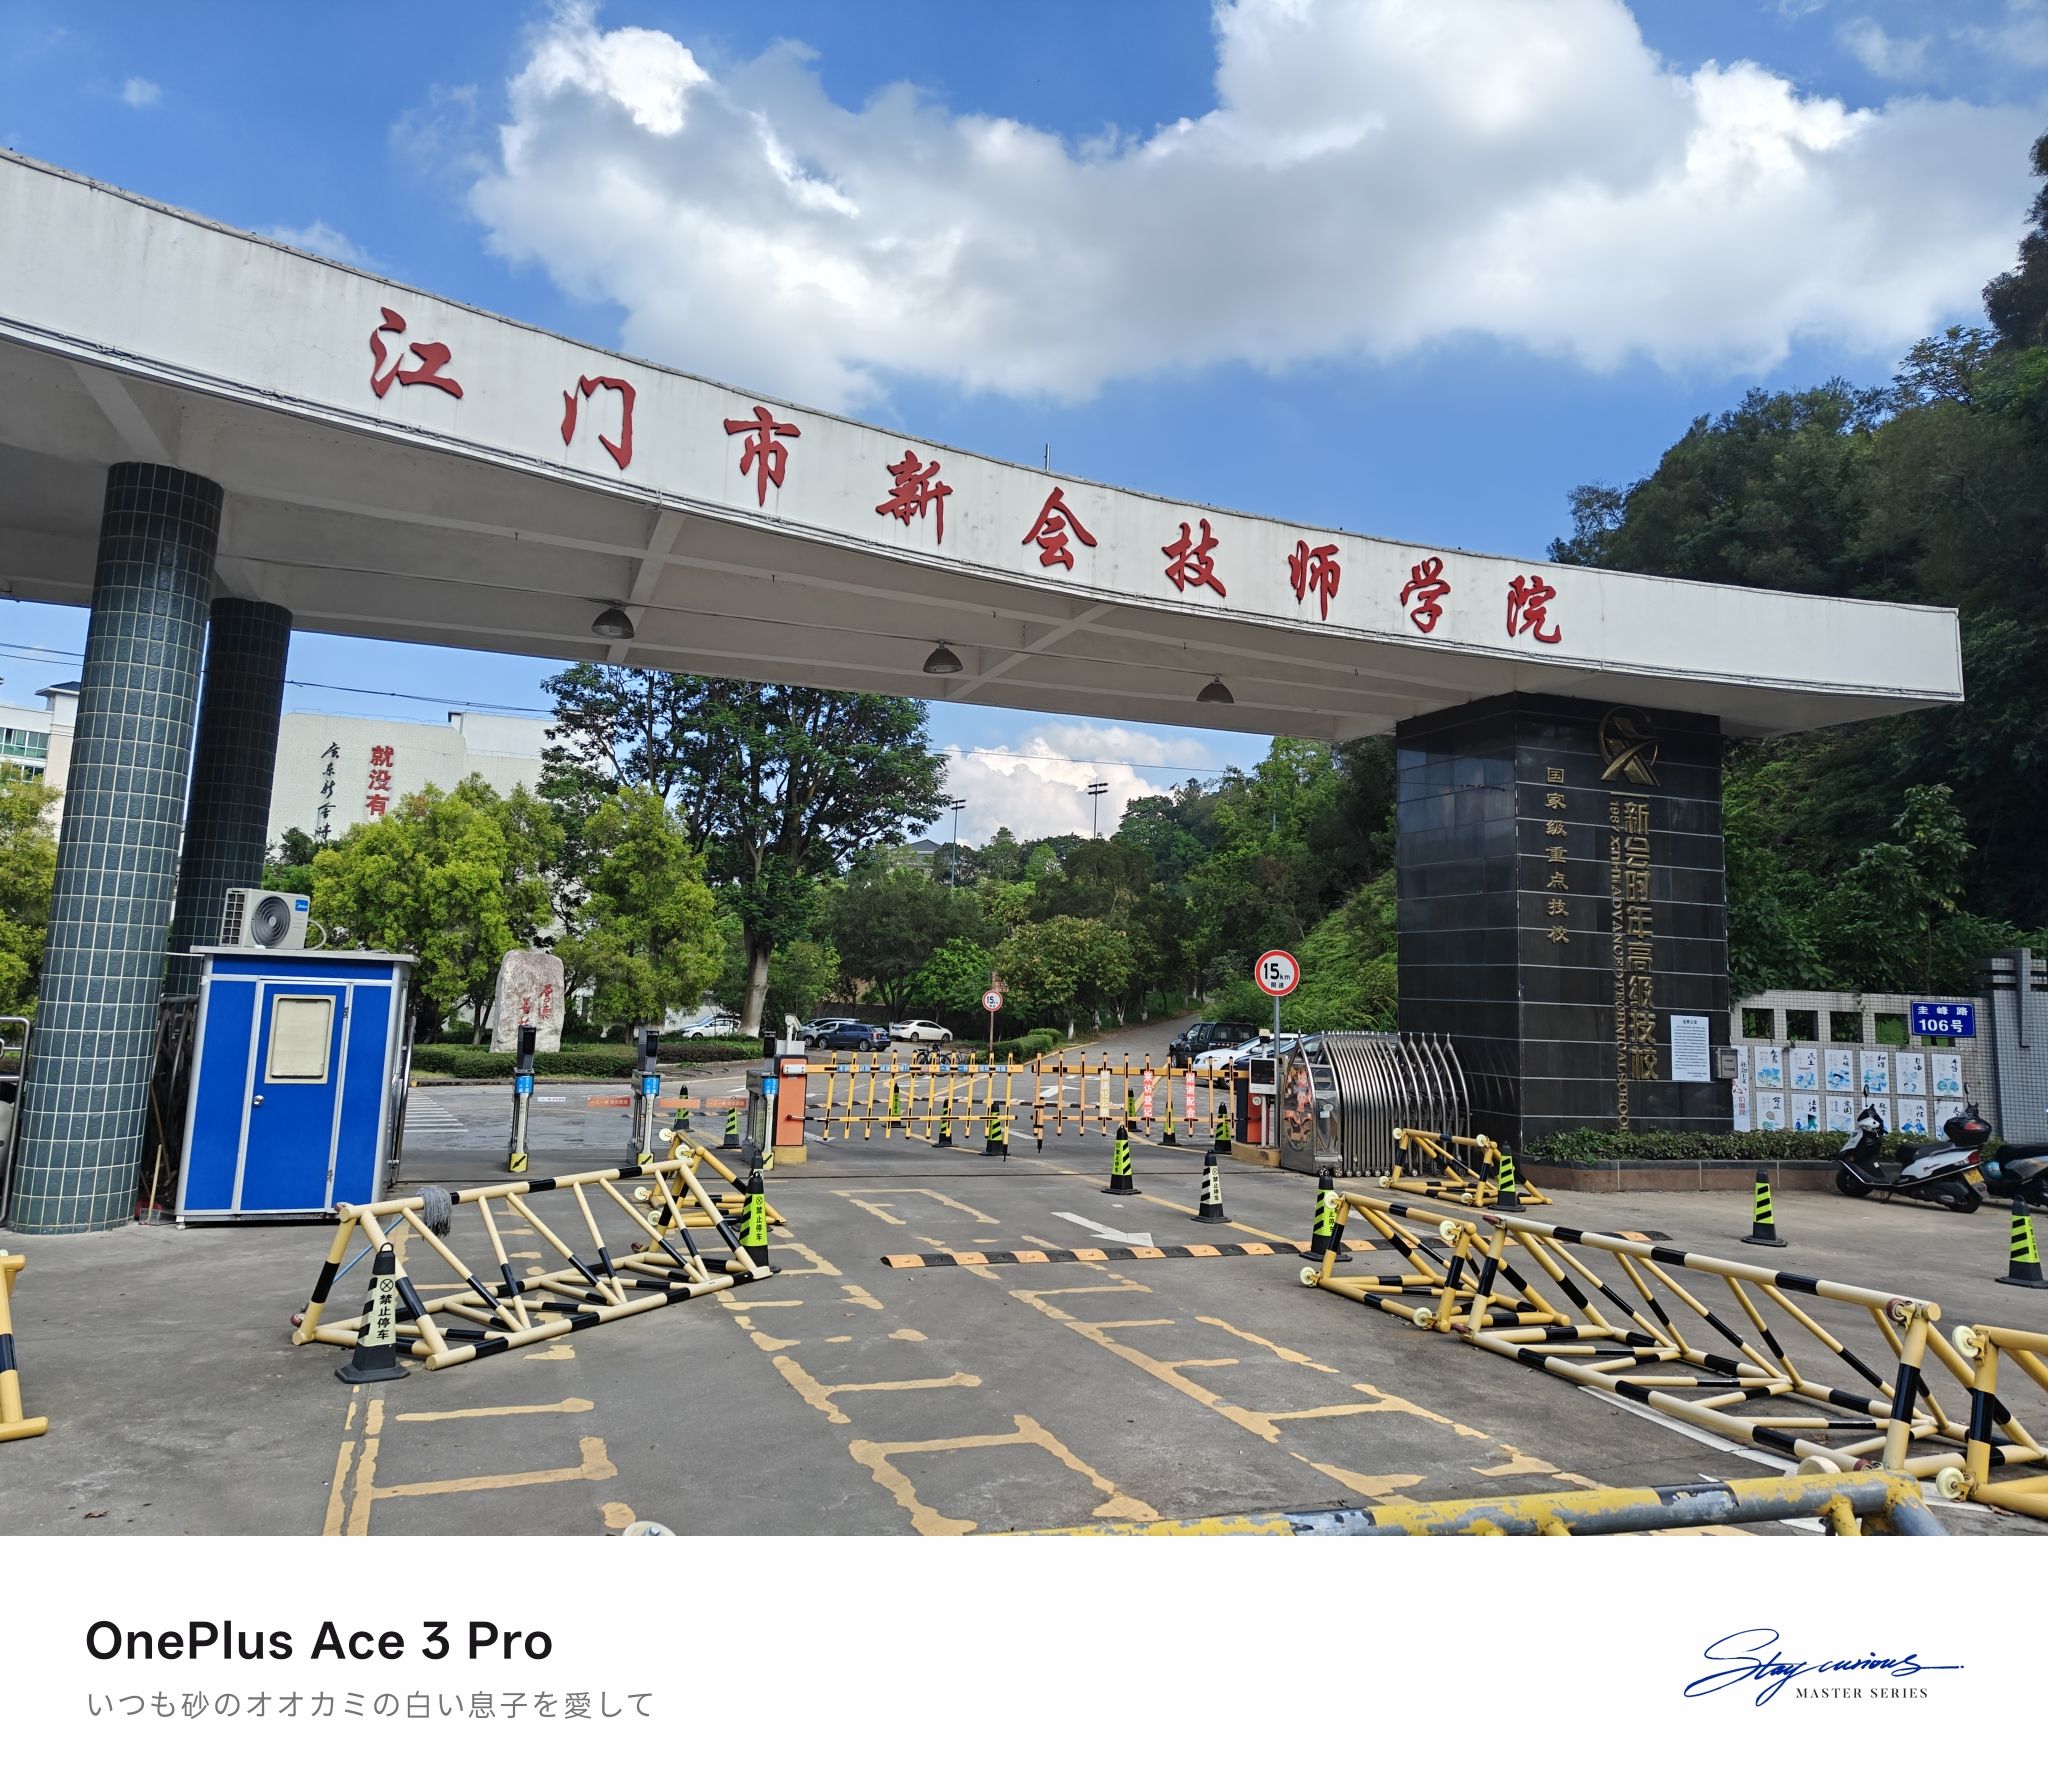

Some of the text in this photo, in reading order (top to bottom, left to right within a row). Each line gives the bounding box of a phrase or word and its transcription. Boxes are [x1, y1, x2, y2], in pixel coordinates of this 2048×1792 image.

[370, 306, 1562, 644] 江门市新会技师学院
[365, 746, 394, 816] 就没有
[1609, 801, 1620, 832] 1987
[1546, 767, 1570, 944] 国家级重点技校
[1611, 885, 1624, 979] ADVANCED
[1917, 1005, 1969, 1016] 圭峰路
[1919, 1019, 1964, 1033] 106号
[755, 1206, 763, 1241] 禁止停车
[376, 1294, 393, 1340] 禁止停车
